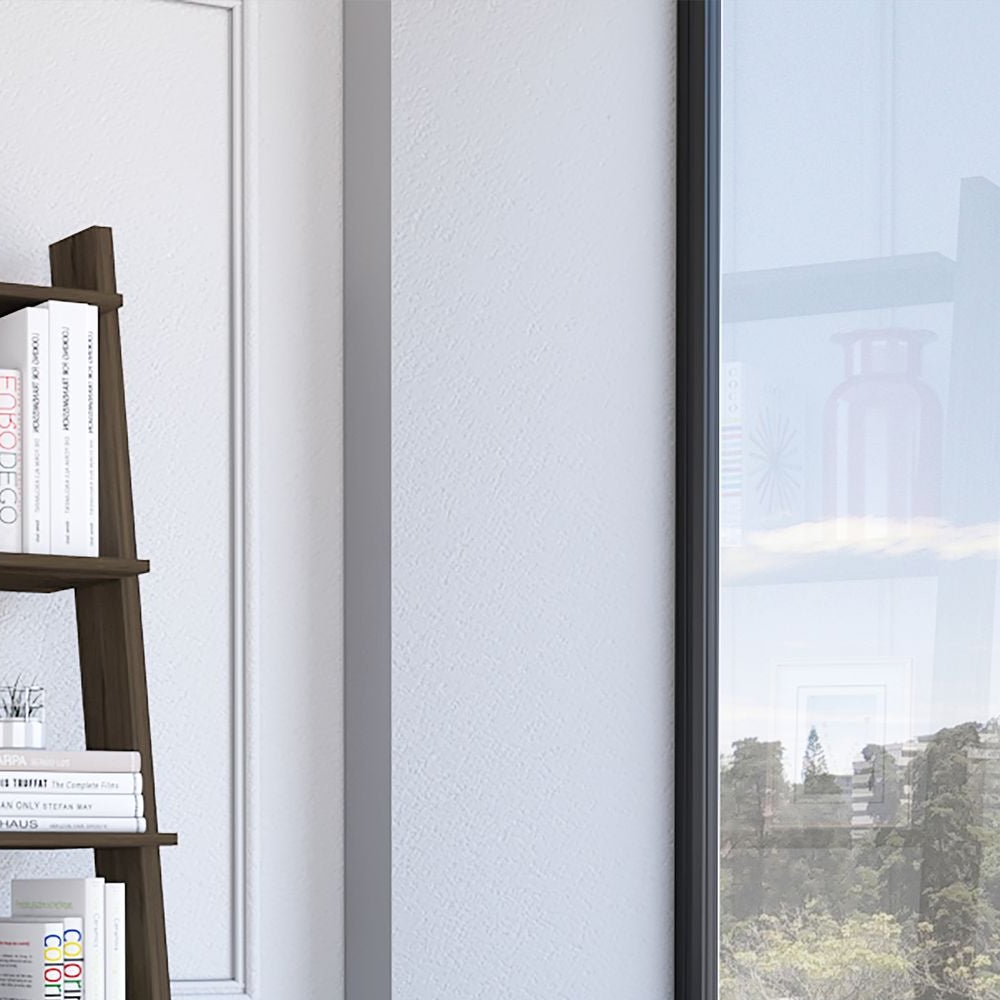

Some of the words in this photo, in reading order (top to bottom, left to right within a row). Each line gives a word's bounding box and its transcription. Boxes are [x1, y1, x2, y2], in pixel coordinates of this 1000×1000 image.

[13, 778, 48, 788] TRUFFAT
[66, 781, 99, 791] Complete
[101, 781, 119, 789] Films
[15, 801, 40, 810] ONLY
[43, 802, 74, 810] STEFAN
